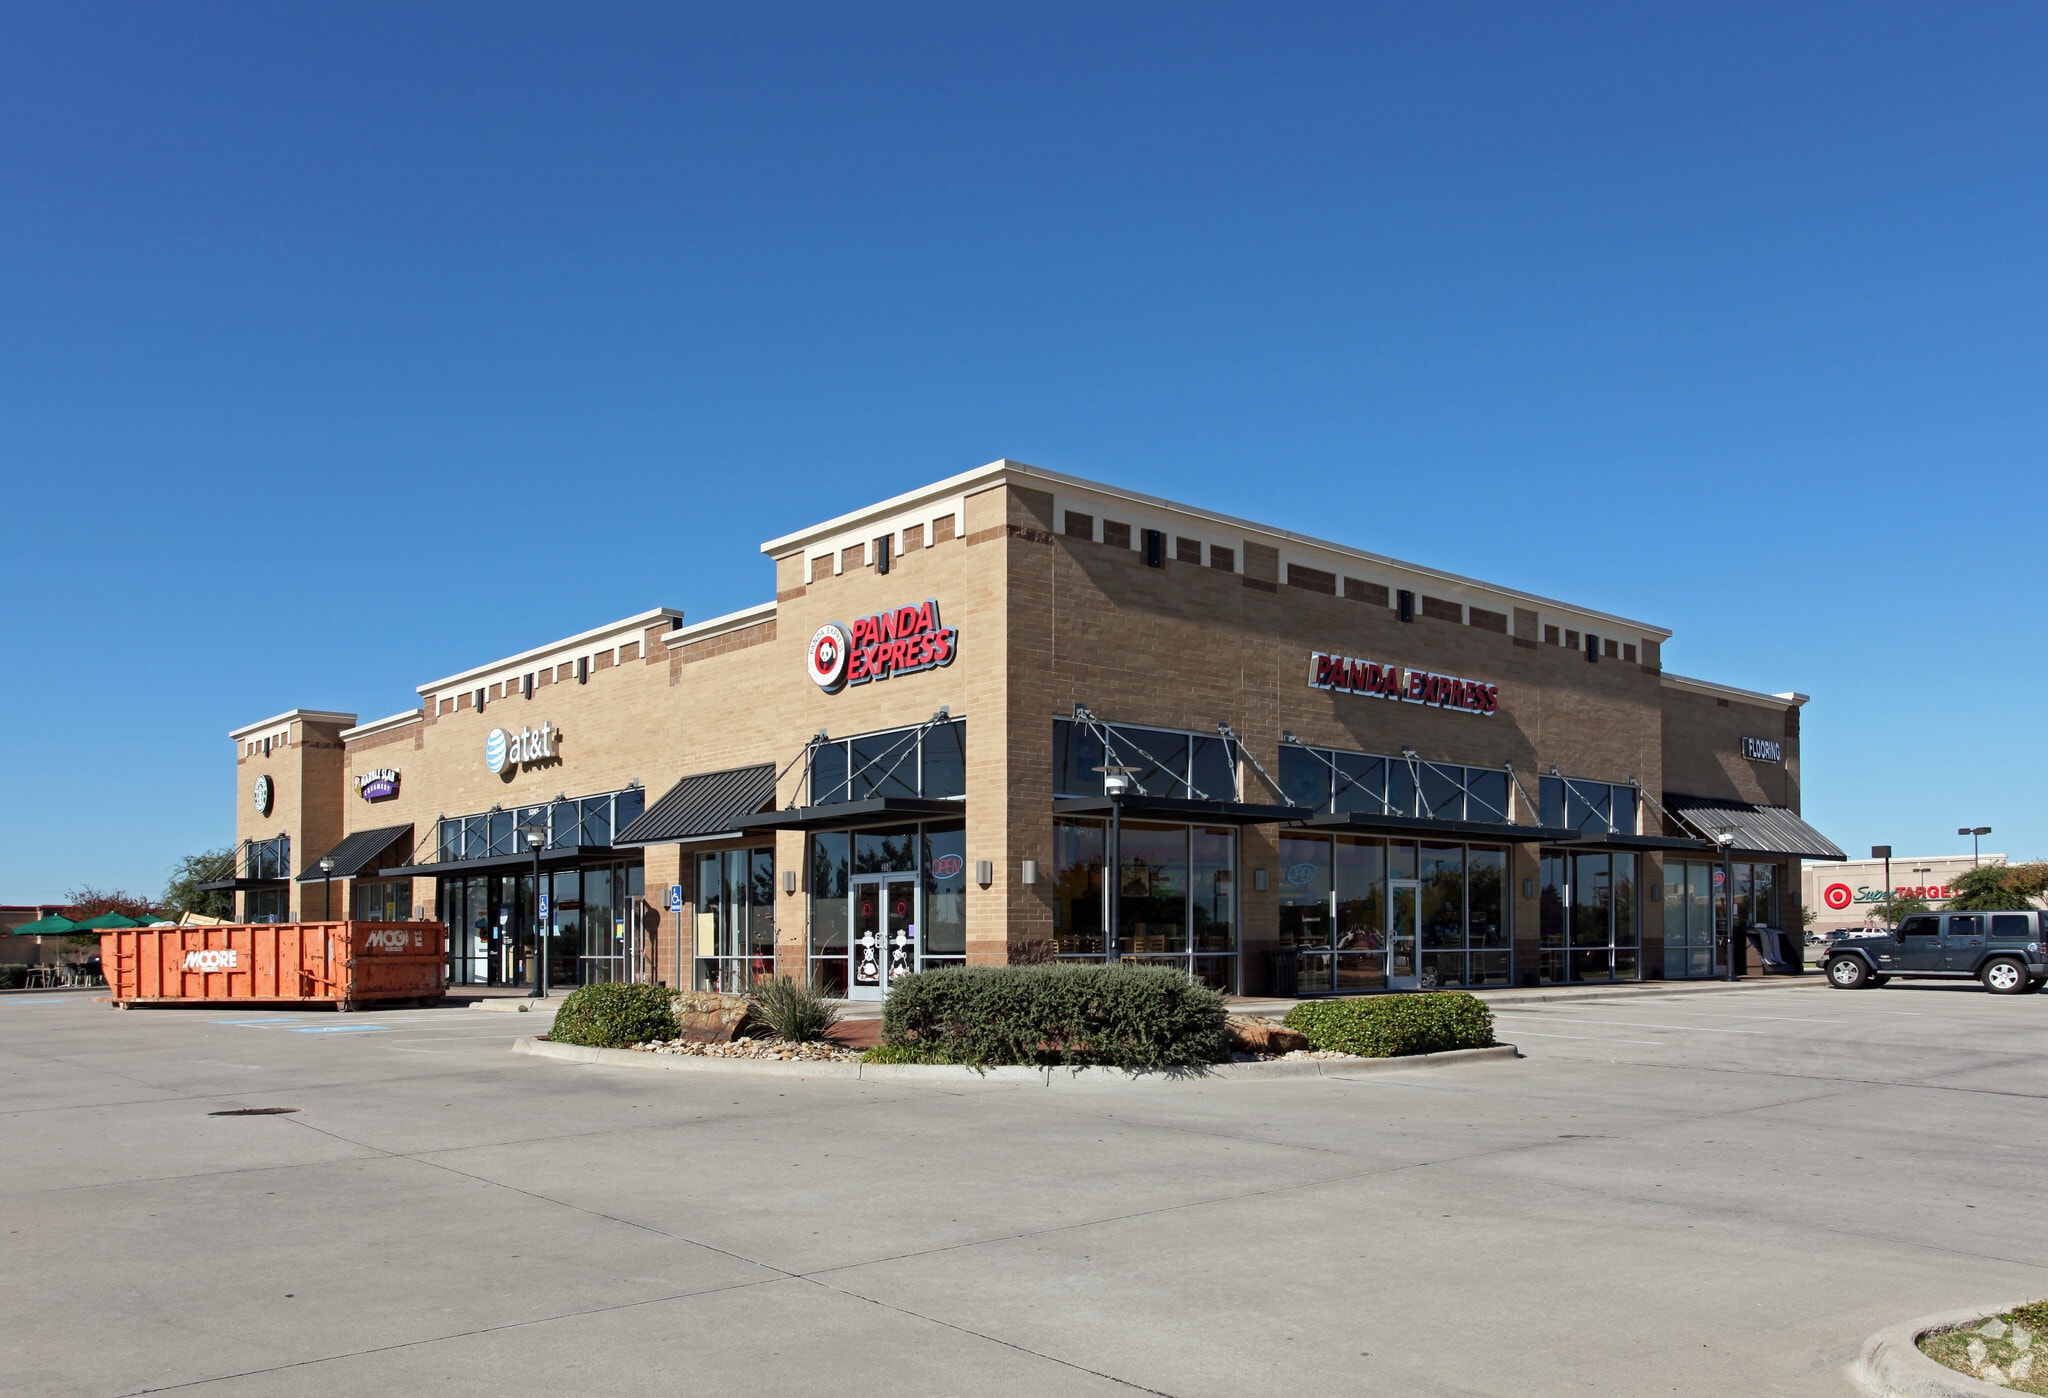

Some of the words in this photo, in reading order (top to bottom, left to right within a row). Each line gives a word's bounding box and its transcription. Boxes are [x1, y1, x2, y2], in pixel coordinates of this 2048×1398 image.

[851, 601, 933, 649] PANDA
[847, 629, 951, 681] EXPRESS
[1312, 653, 1399, 698] PANDA
[1406, 670, 1499, 713] EXPRESS
[509, 720, 552, 765] at&t
[1748, 738, 1781, 762] FLOORING
[932, 858, 961, 876] OPEN
[1288, 866, 1316, 882] OPEN
[365, 929, 423, 948] MOOE
[182, 950, 237, 969] MOORE
